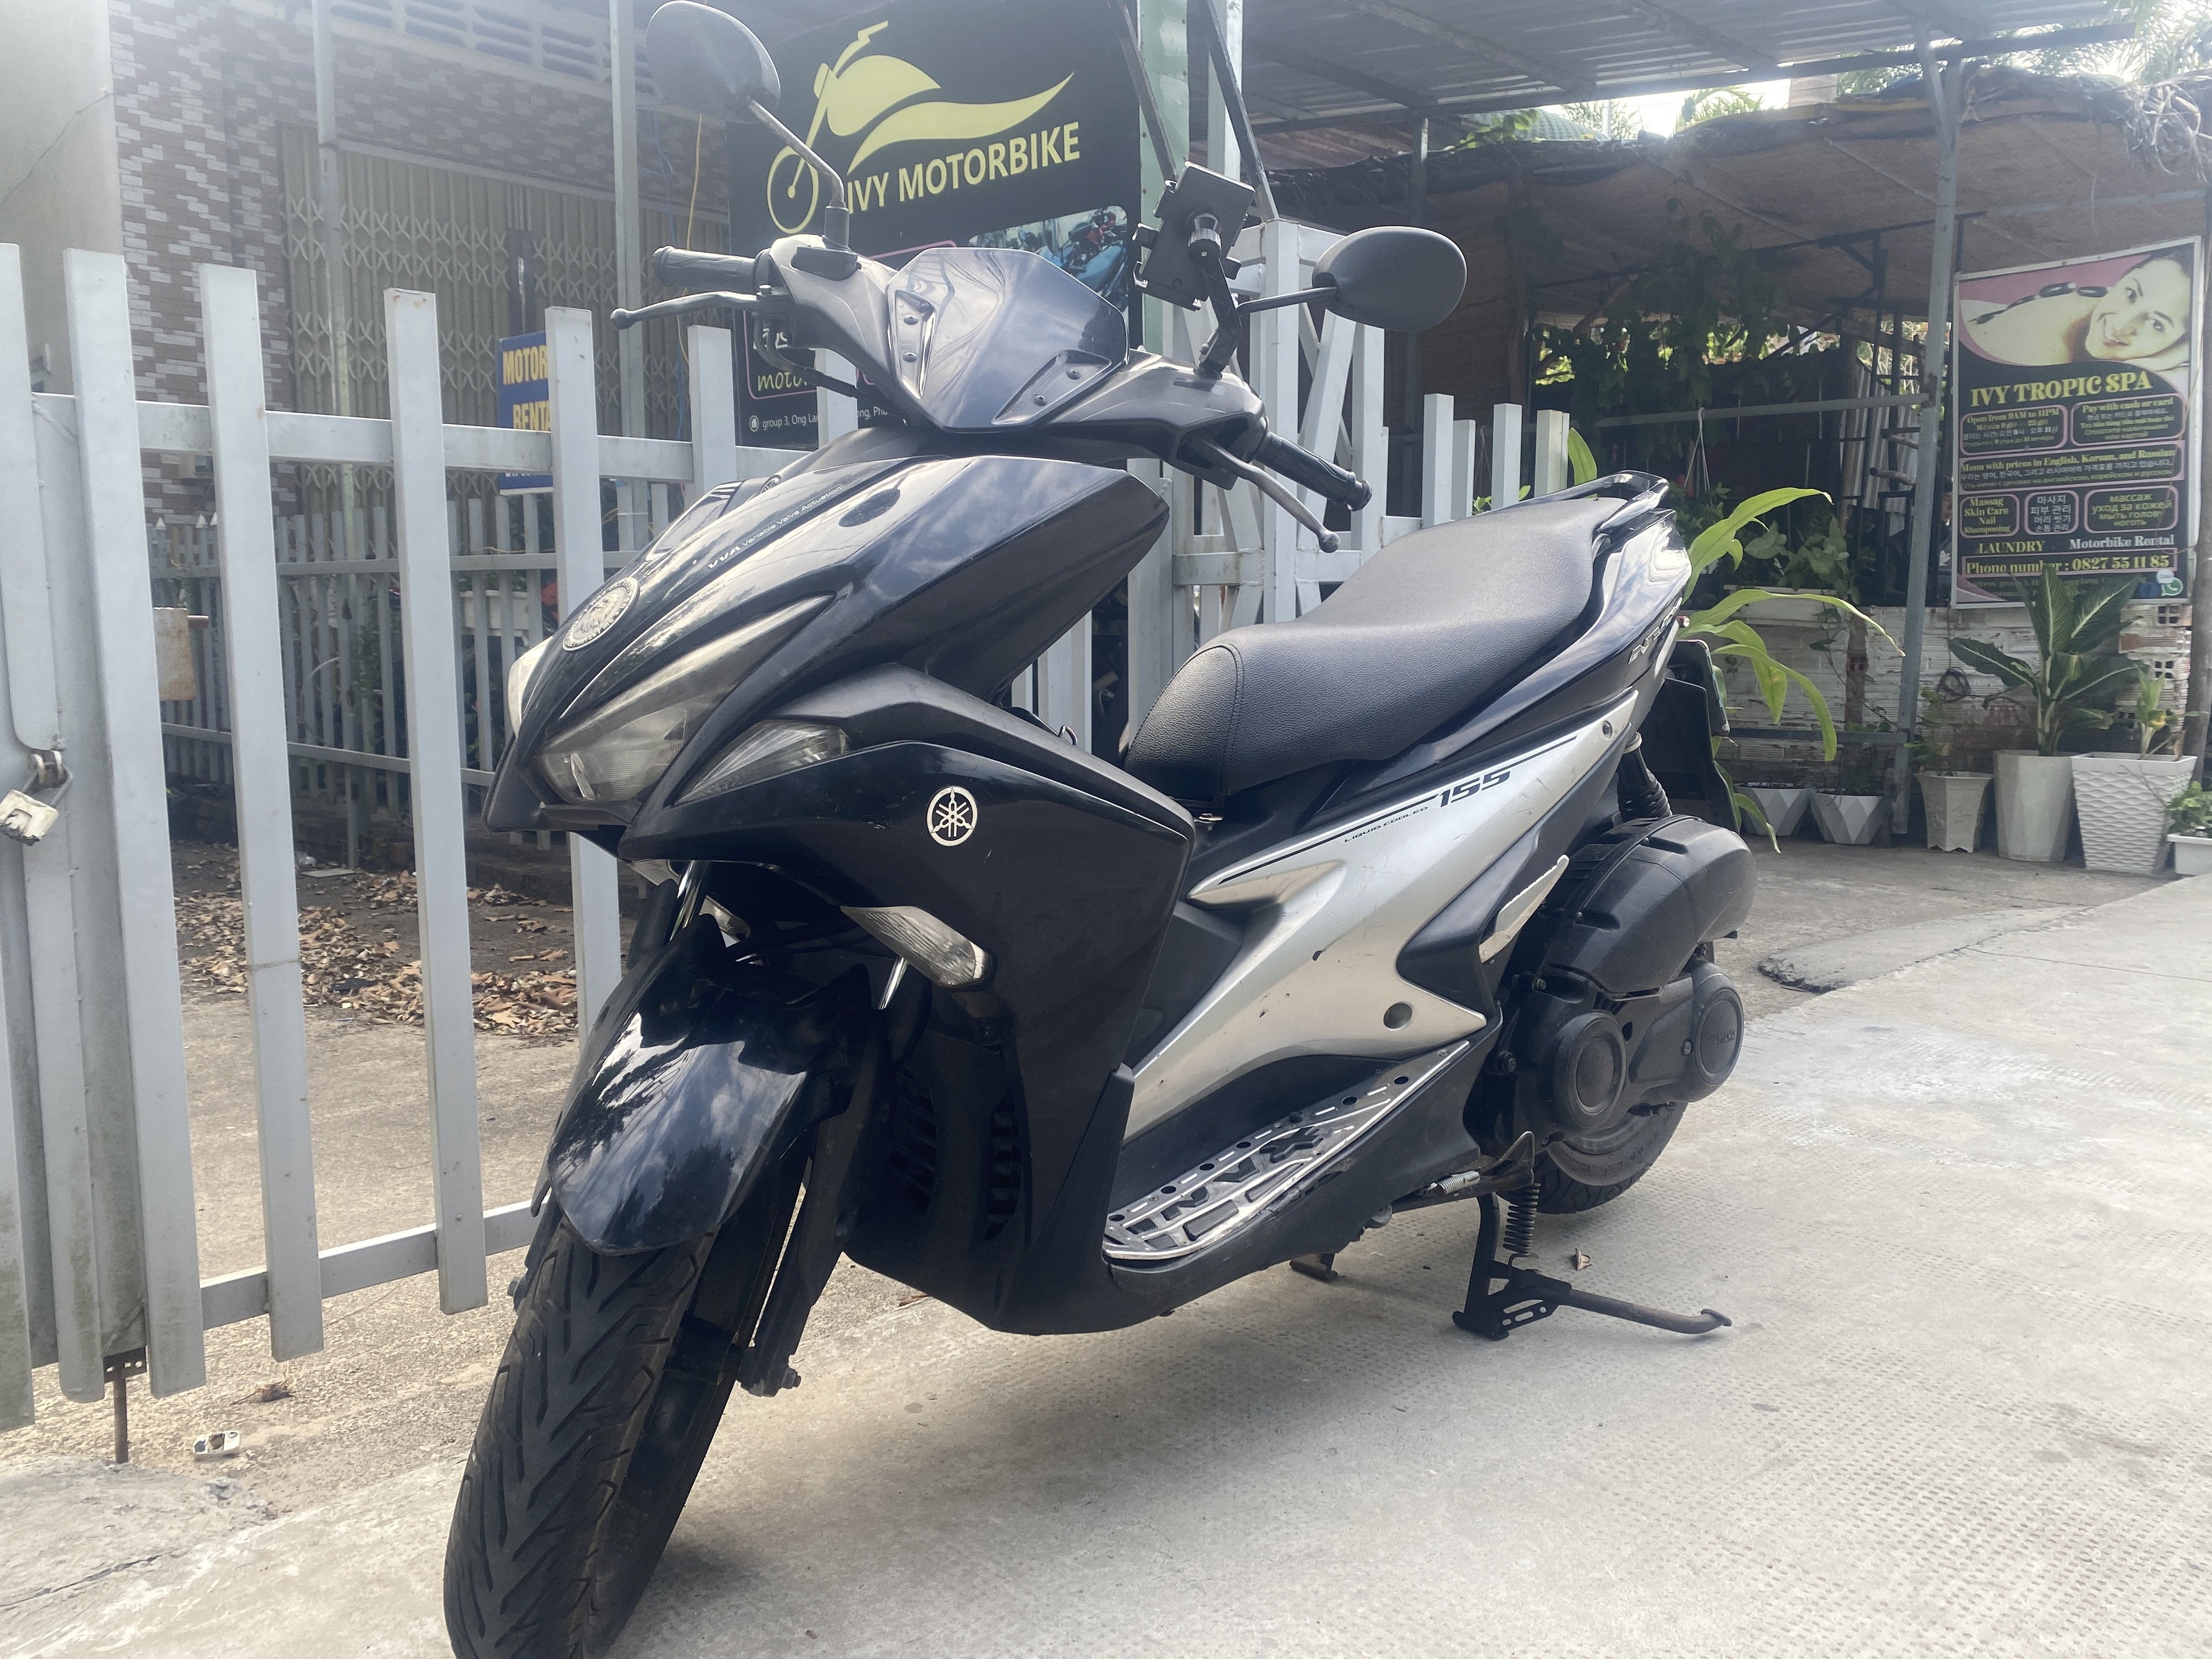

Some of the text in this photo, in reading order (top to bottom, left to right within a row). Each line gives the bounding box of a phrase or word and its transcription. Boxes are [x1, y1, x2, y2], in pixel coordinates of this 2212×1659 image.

[847, 121, 1080, 214] IVY MOTORBIKE
[1971, 371, 2153, 407] IVY TROPIC SPA
[763, 419, 782, 431] group
[784, 416, 790, 426] 3,
[792, 415, 806, 426] Ong
[1961, 464, 1984, 472] Menu
[1986, 461, 2004, 470] with
[2006, 460, 2032, 470] prices
[1970, 497, 2004, 507] Massag
[2037, 495, 2066, 505] 마사지
[2110, 494, 2152, 503] массаж
[1965, 506, 2009, 516] Skin Care
[2030, 504, 2072, 515] 피부 관리
[2092, 505, 2118, 515] уход
[1979, 516, 1996, 525] Nail
[2034, 516, 2051, 524] 머리
[708, 486, 843, 569] VVA Variable Valve Actuation
[1978, 534, 2175, 554] LAUNDRY Motorbike Rental
[1966, 562, 2007, 574] Phone
[2072, 557, 2109, 571] 0827
[2112, 556, 2130, 569] 55
[2134, 556, 2146, 568] 11
[2150, 555, 2170, 568] 85
[1440, 770, 1510, 808] 155
[1345, 806, 1428, 843] LIQUID COOLED
